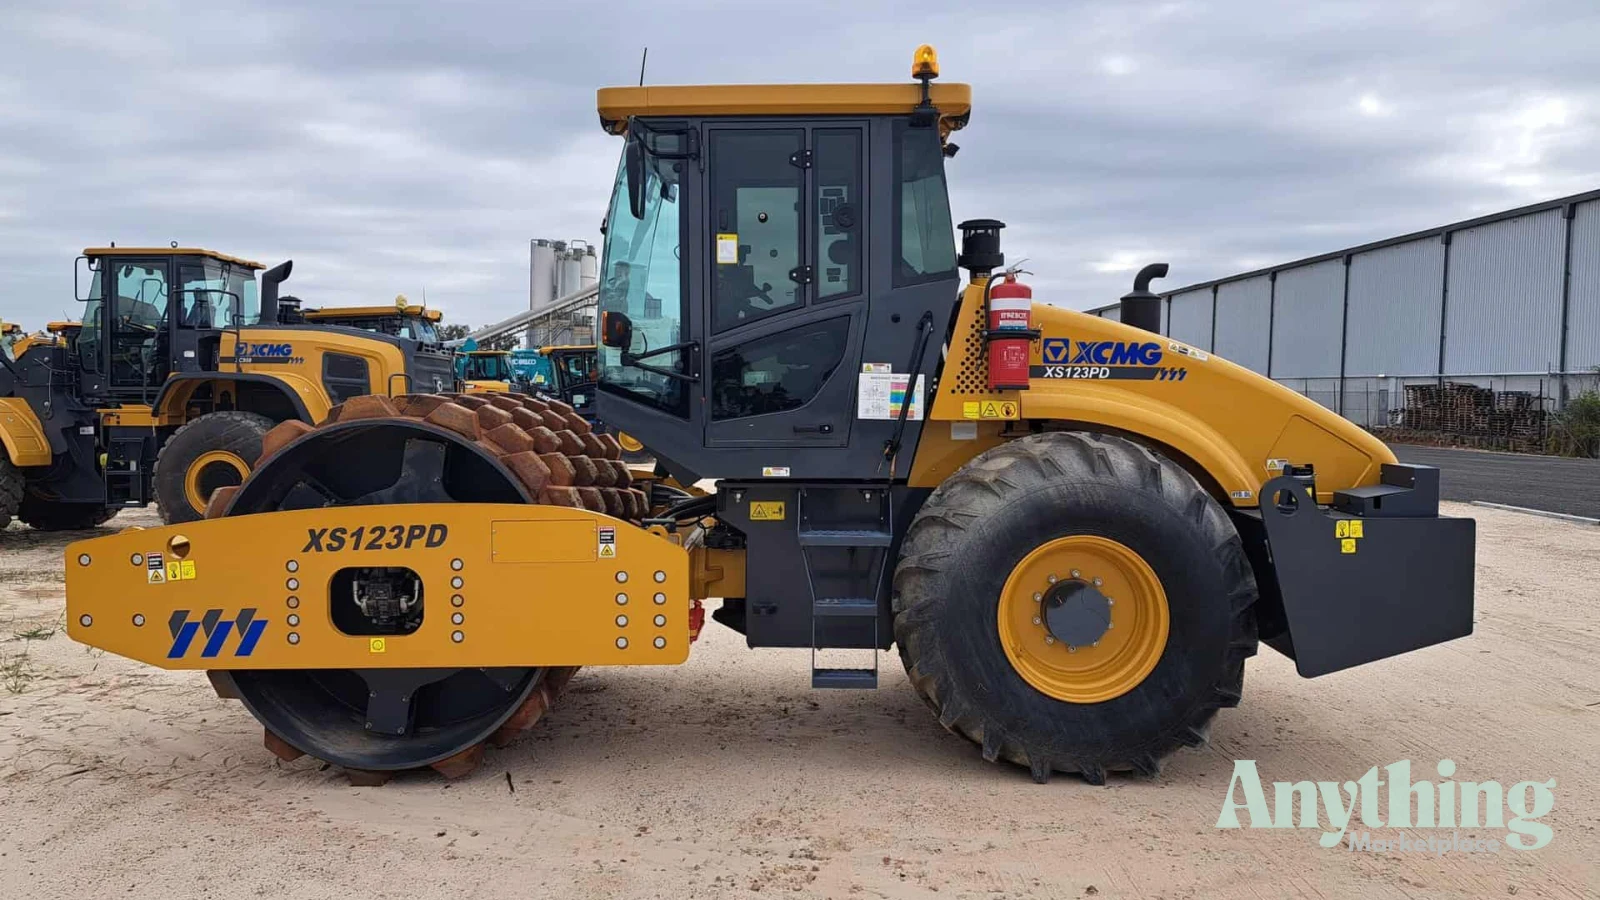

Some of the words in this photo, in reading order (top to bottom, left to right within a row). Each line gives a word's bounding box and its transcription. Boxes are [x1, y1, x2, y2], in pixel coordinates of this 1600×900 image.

[250, 343, 292, 357] XCMG
[1070, 342, 1163, 366] XCMG
[1044, 367, 1111, 379] XS123PD
[302, 524, 448, 553] XS123PD
